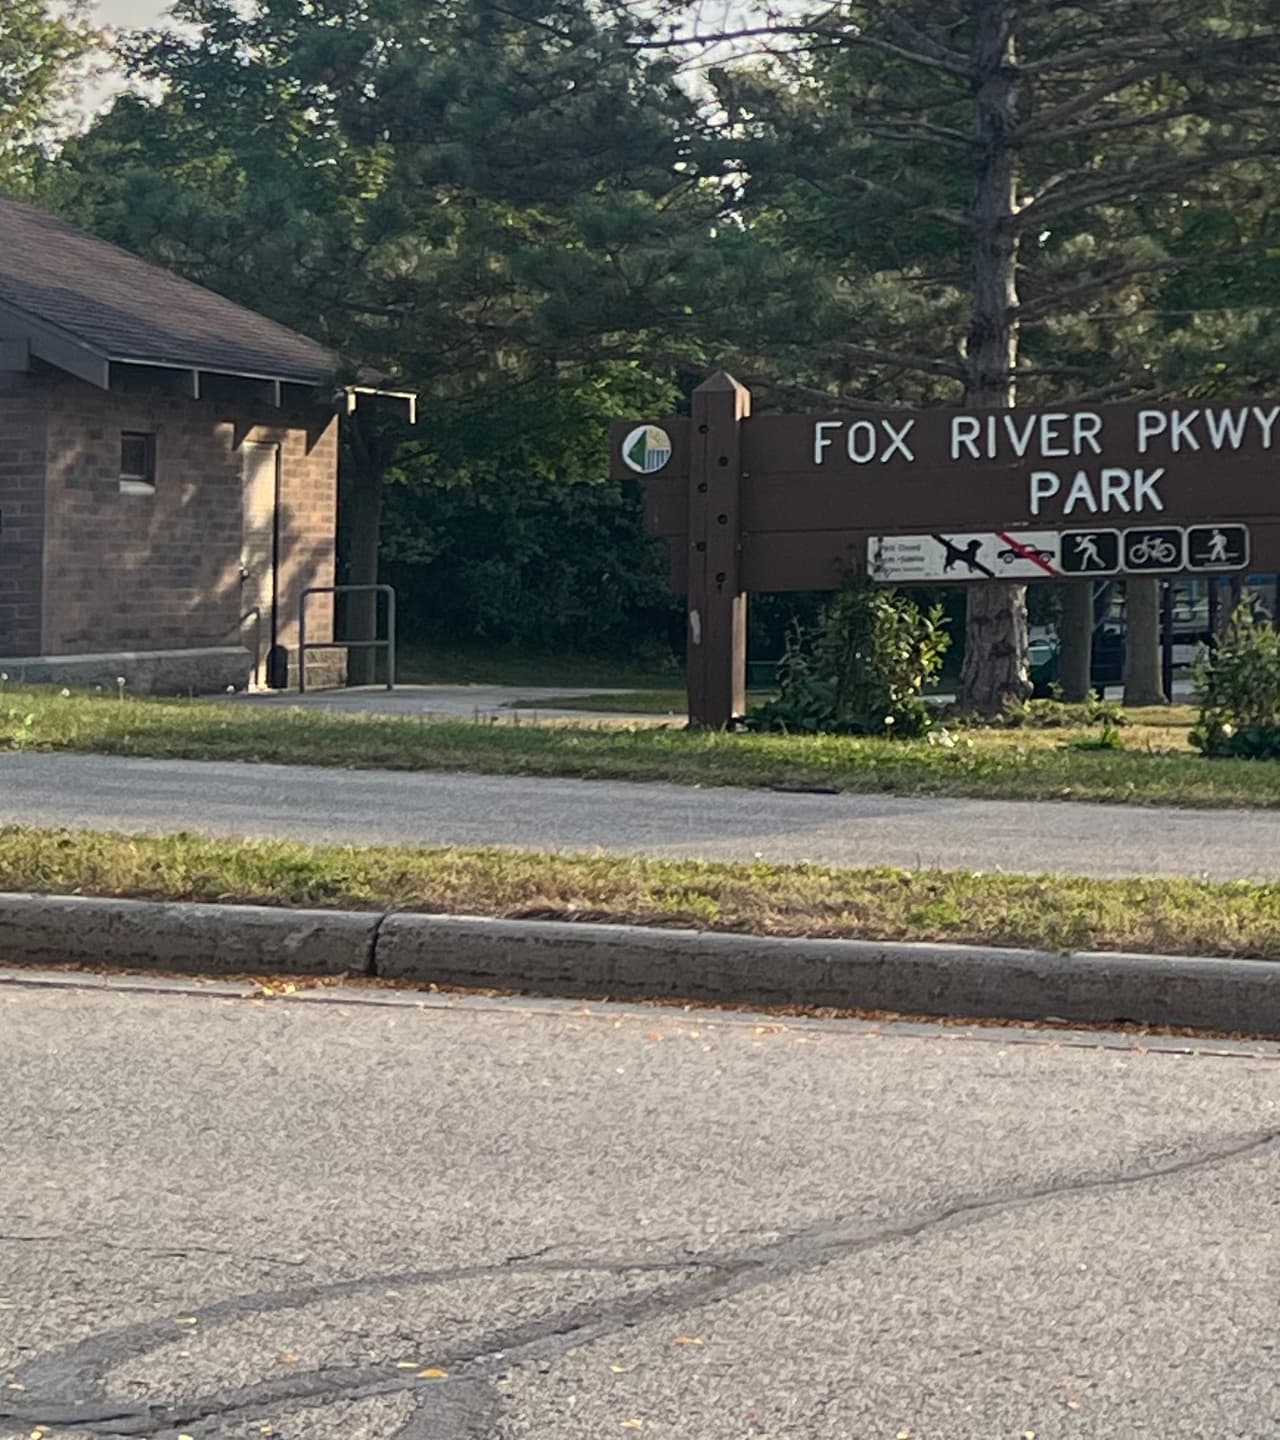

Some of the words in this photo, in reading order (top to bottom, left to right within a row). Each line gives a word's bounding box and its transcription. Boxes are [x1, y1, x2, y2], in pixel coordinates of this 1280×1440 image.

[814, 418, 915, 465] FOX
[950, 411, 1103, 460] RIVER
[1029, 467, 1165, 516] PARK
